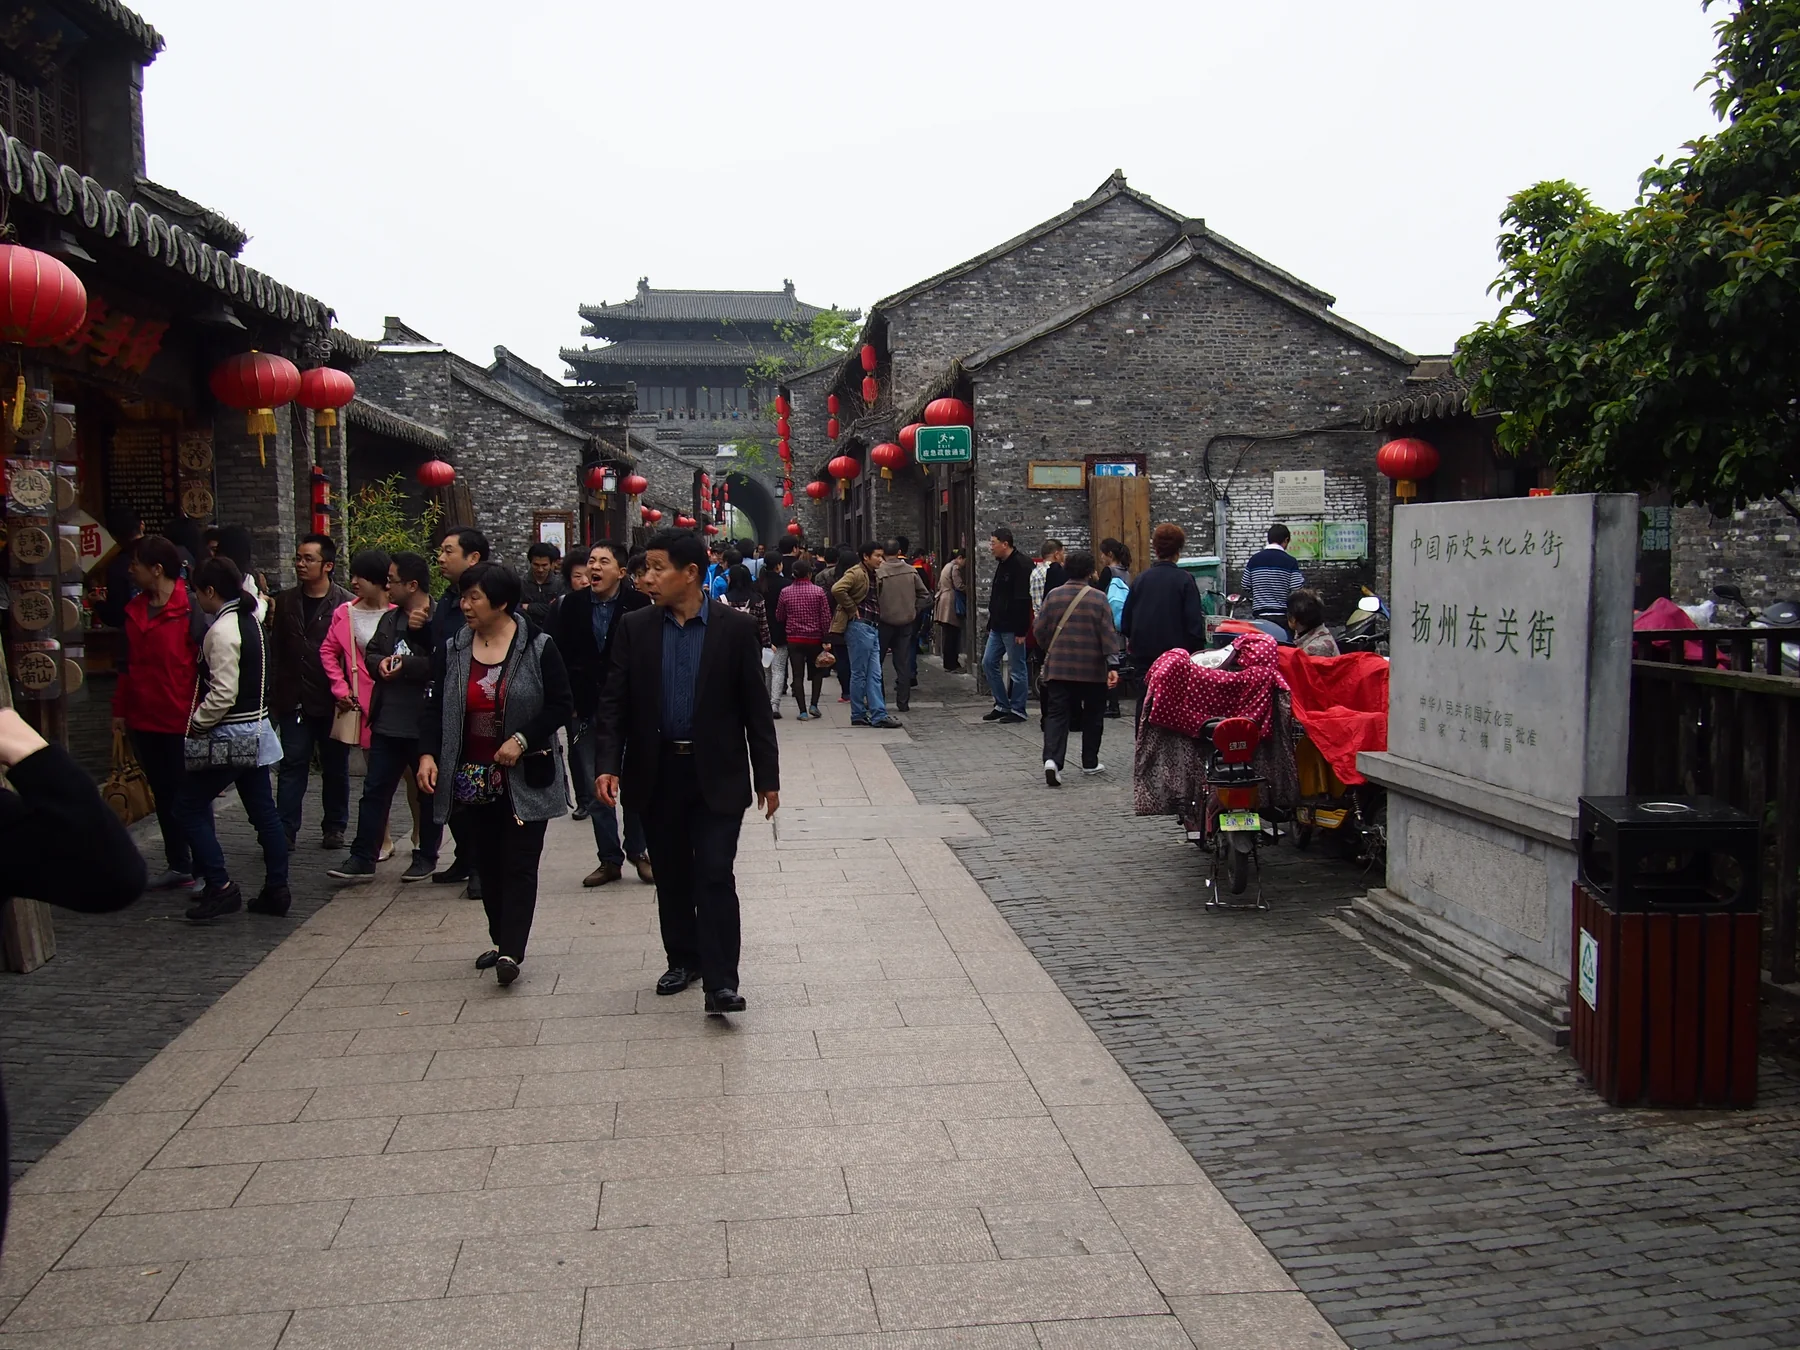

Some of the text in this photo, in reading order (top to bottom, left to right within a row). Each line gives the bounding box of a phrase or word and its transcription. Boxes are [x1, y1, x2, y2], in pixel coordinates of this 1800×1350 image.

[16, 474, 44, 492] 老妈
[18, 533, 45, 545] 吉祥
[19, 545, 45, 557] 如意
[1410, 529, 1564, 568] 中国历史文化名街
[20, 598, 46, 610] 福如
[22, 609, 49, 622] 东海
[1411, 600, 1555, 661] 扬州东关街
[19, 656, 53, 670] 寿比
[20, 670, 52, 685] 南山
[1420, 695, 1513, 728] 中华人民共和国文化部
